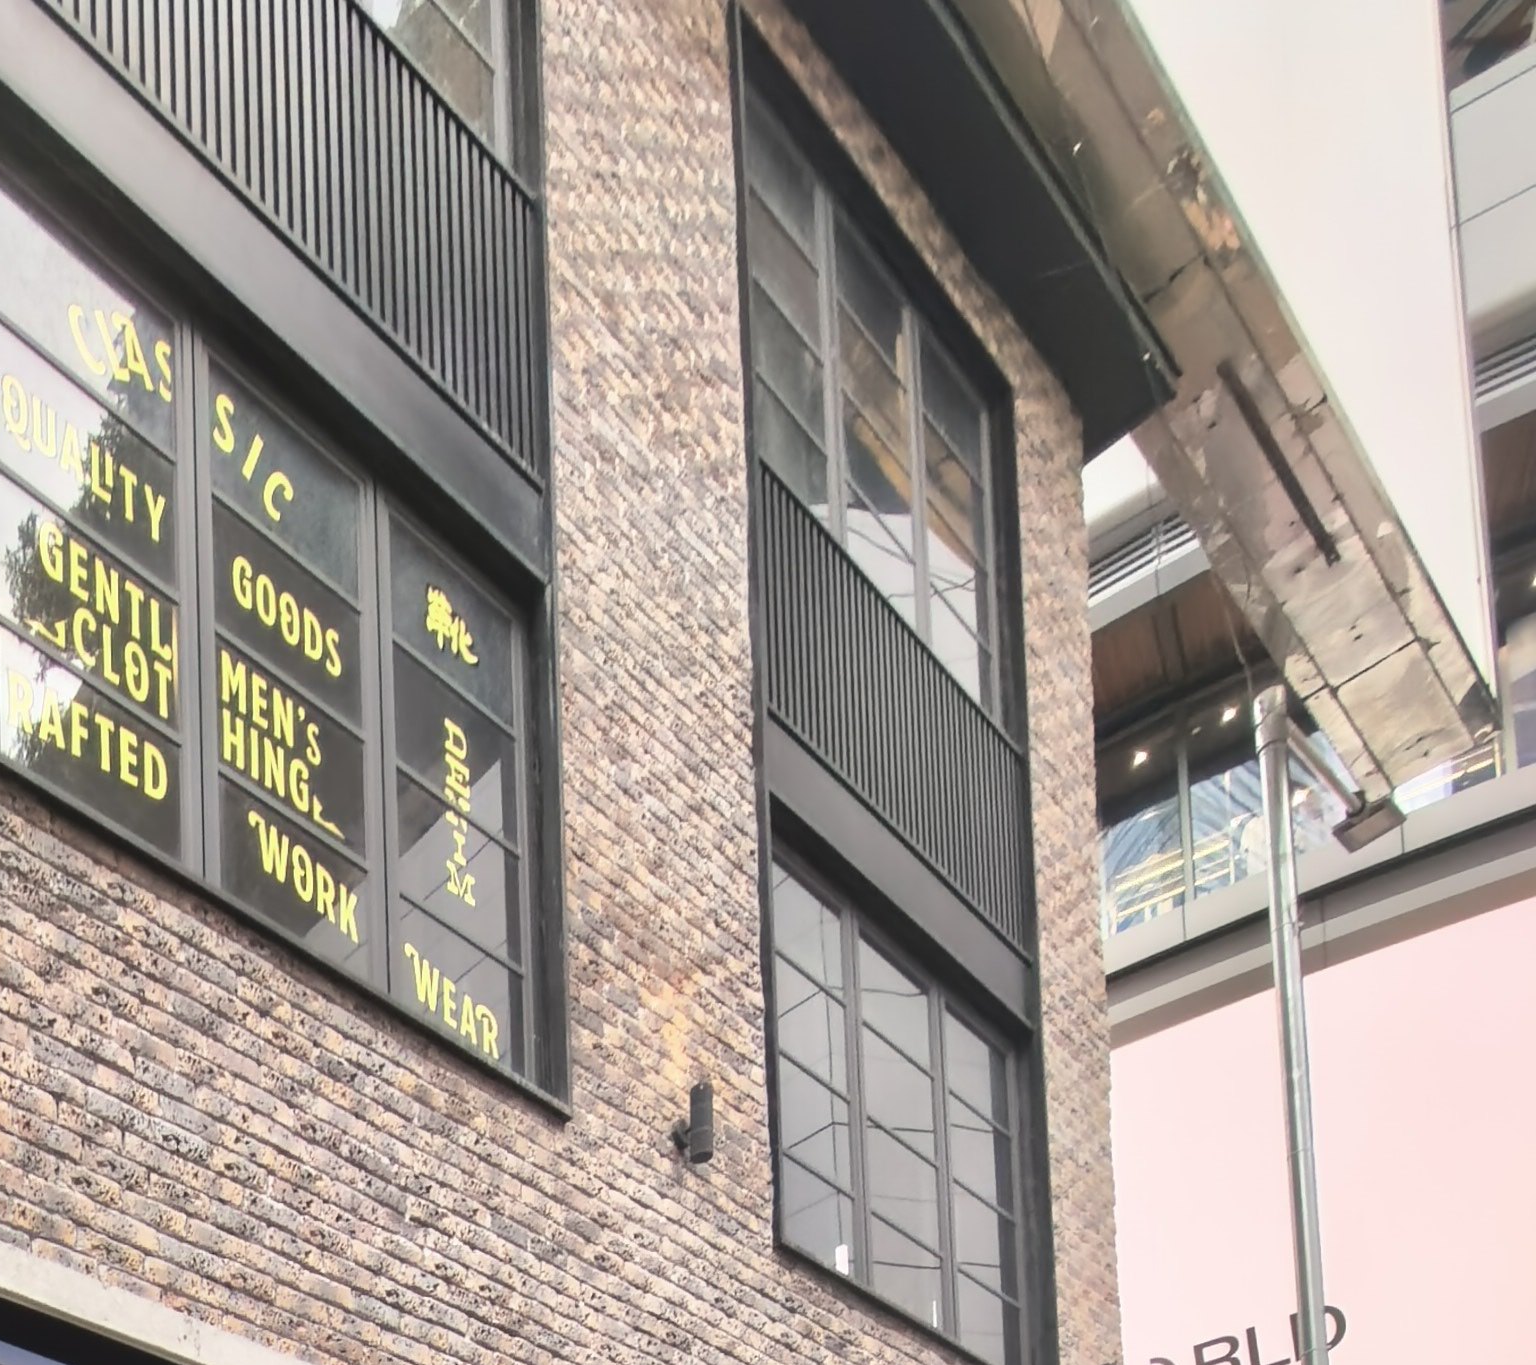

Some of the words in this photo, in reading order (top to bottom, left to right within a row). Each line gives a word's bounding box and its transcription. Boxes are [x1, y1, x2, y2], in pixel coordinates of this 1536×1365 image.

[1, 374, 166, 543] QUALITY
[232, 556, 342, 678] GOODS
[248, 810, 359, 945] WORK
[404, 942, 500, 1060] WEAR
